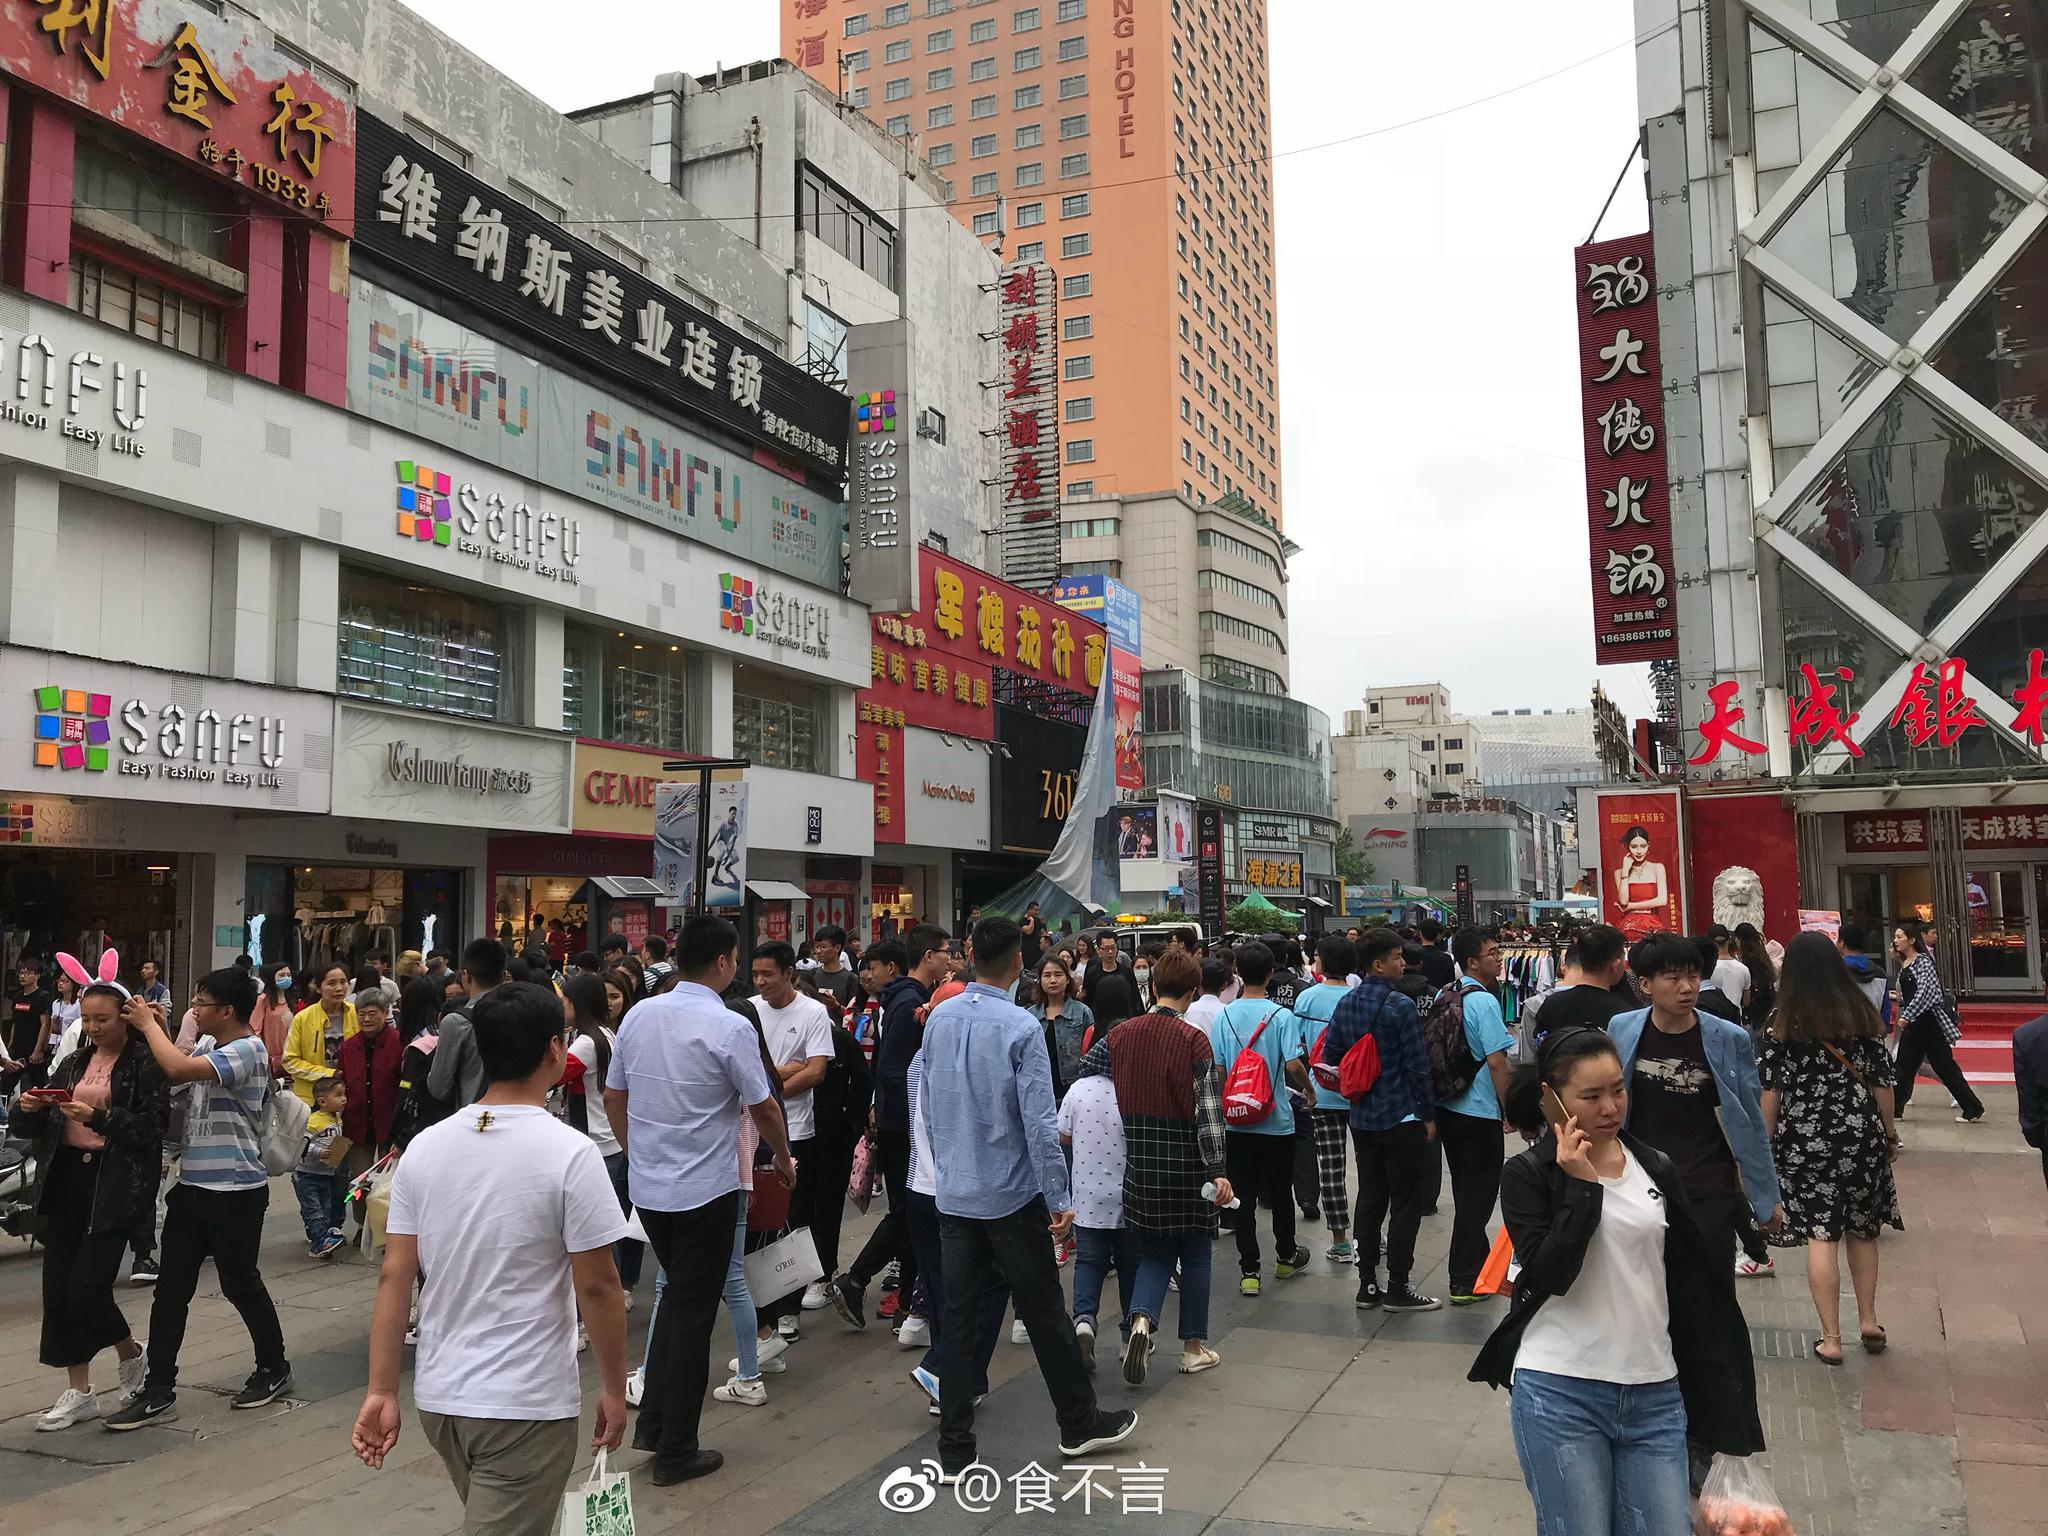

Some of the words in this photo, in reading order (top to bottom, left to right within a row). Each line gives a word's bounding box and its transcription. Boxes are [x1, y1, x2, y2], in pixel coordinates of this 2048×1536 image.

[1114, 47, 1136, 160] HOTEL
[376, 154, 765, 416] 维纳斯美业连锁
[1003, 265, 1041, 501] 刘胡兰酒店
[61, 418, 106, 450] Easy
[112, 433, 146, 457] Life
[858, 441, 867, 464] Easy
[586, 409, 741, 533] SANFU
[859, 466, 867, 502] Fashion
[859, 508, 867, 529] Easy
[458, 537, 485, 559] Easy
[486, 546, 531, 571] Fashion
[535, 560, 561, 583] Easy
[562, 568, 582, 586] Life
[1600, 629, 1672, 644] 18638681106
[872, 644, 906, 684] 美味
[912, 658, 949, 696] 营养
[954, 670, 988, 708] 健康
[119, 759, 155, 779] Easy
[159, 764, 217, 784] Fashion
[224, 770, 256, 790] Easy
[258, 773, 284, 788] Life
[493, 768, 533, 794] 淑女坊
[584, 769, 679, 808] GEME
[1853, 818, 1925, 845] 共筑爱
[1961, 814, 2048, 842] 天成珠宝
[1245, 857, 1301, 889] 海澜之家
[1226, 1104, 1249, 1118] ANTA
